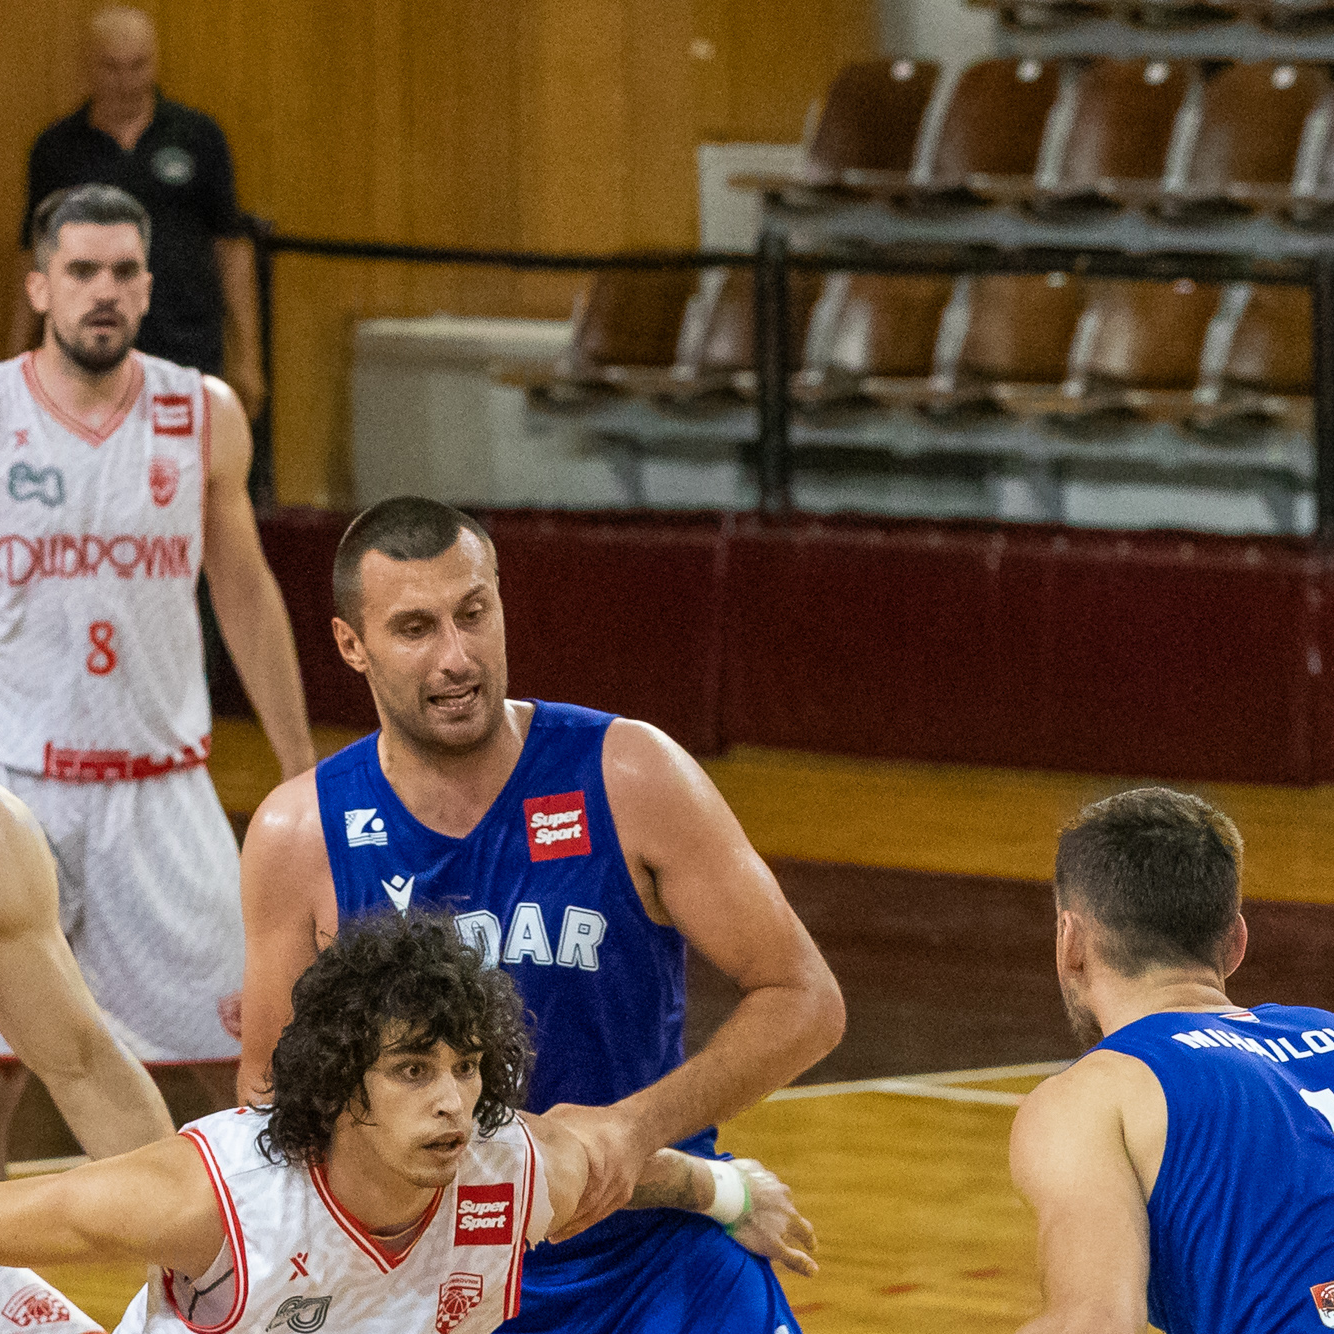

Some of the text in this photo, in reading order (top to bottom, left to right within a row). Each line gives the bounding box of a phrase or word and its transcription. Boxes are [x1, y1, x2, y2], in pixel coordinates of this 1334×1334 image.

[85, 620, 118, 676] 8
[530, 809, 582, 828] Super
[534, 824, 583, 845] Sport
[457, 1199, 510, 1215] Super
[458, 1214, 507, 1231] Sport
